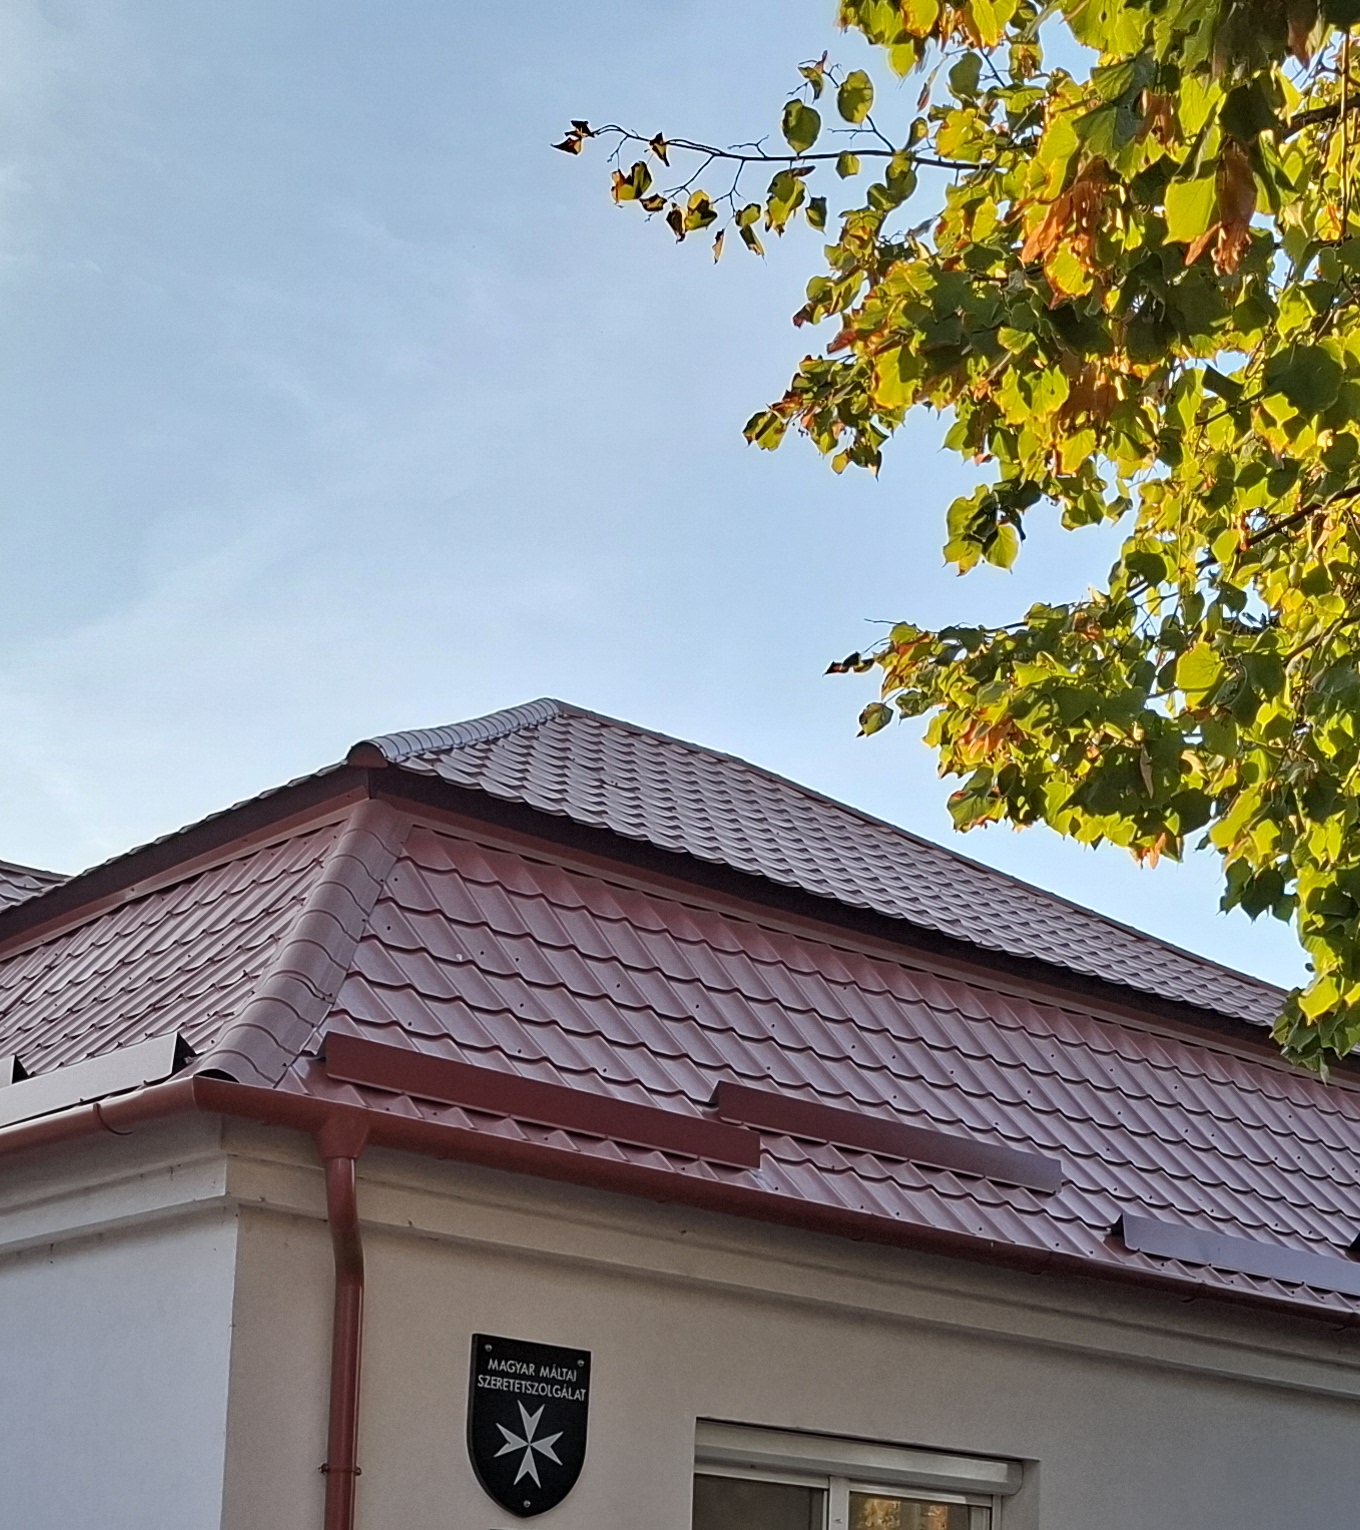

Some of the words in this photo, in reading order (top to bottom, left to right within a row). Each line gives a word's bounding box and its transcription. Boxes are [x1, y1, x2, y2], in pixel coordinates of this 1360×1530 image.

[487, 1358, 535, 1377] MAGYAR
[539, 1363, 578, 1382] MÁLTAI
[477, 1374, 587, 1402] SZERETETSZOLGÁLAT
